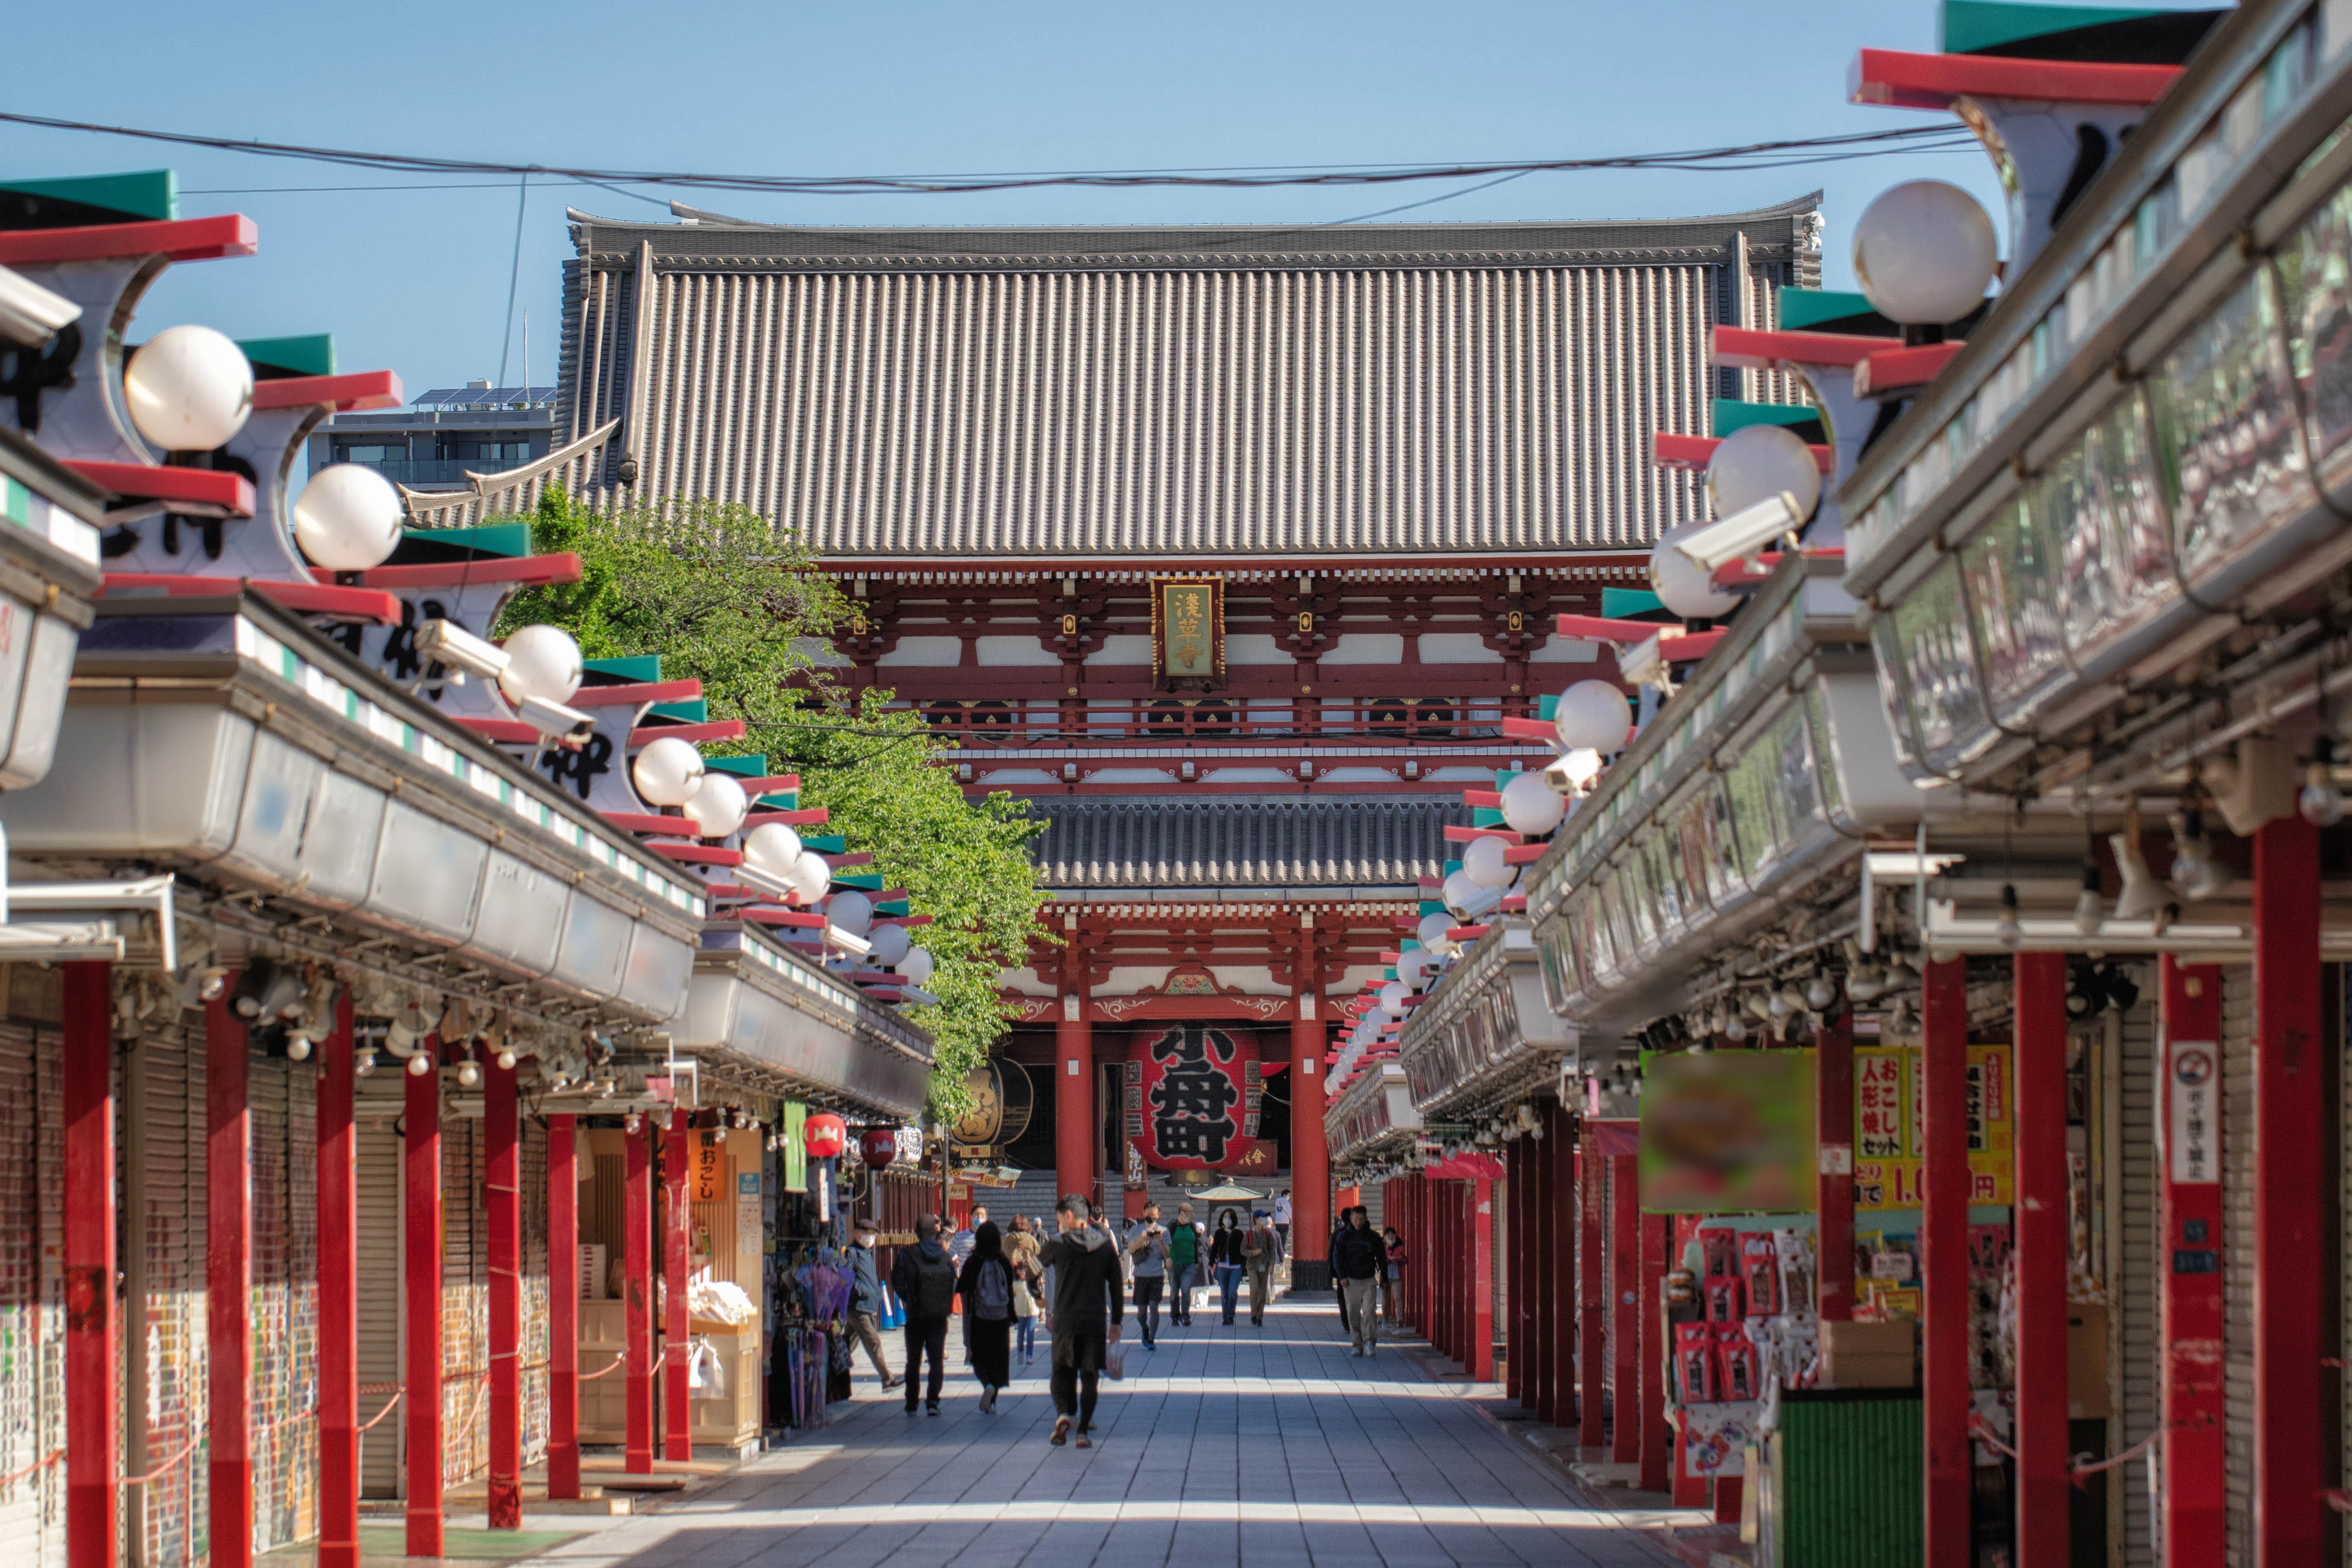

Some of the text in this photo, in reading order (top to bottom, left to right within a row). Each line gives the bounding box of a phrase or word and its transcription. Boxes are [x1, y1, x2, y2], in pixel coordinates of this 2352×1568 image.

[1149, 1022, 1238, 1163] 小舟町
[1862, 1058, 1879, 1135] 人形焼
[1880, 1059, 1898, 1134] おこし
[1863, 1136, 1899, 1155] セット
